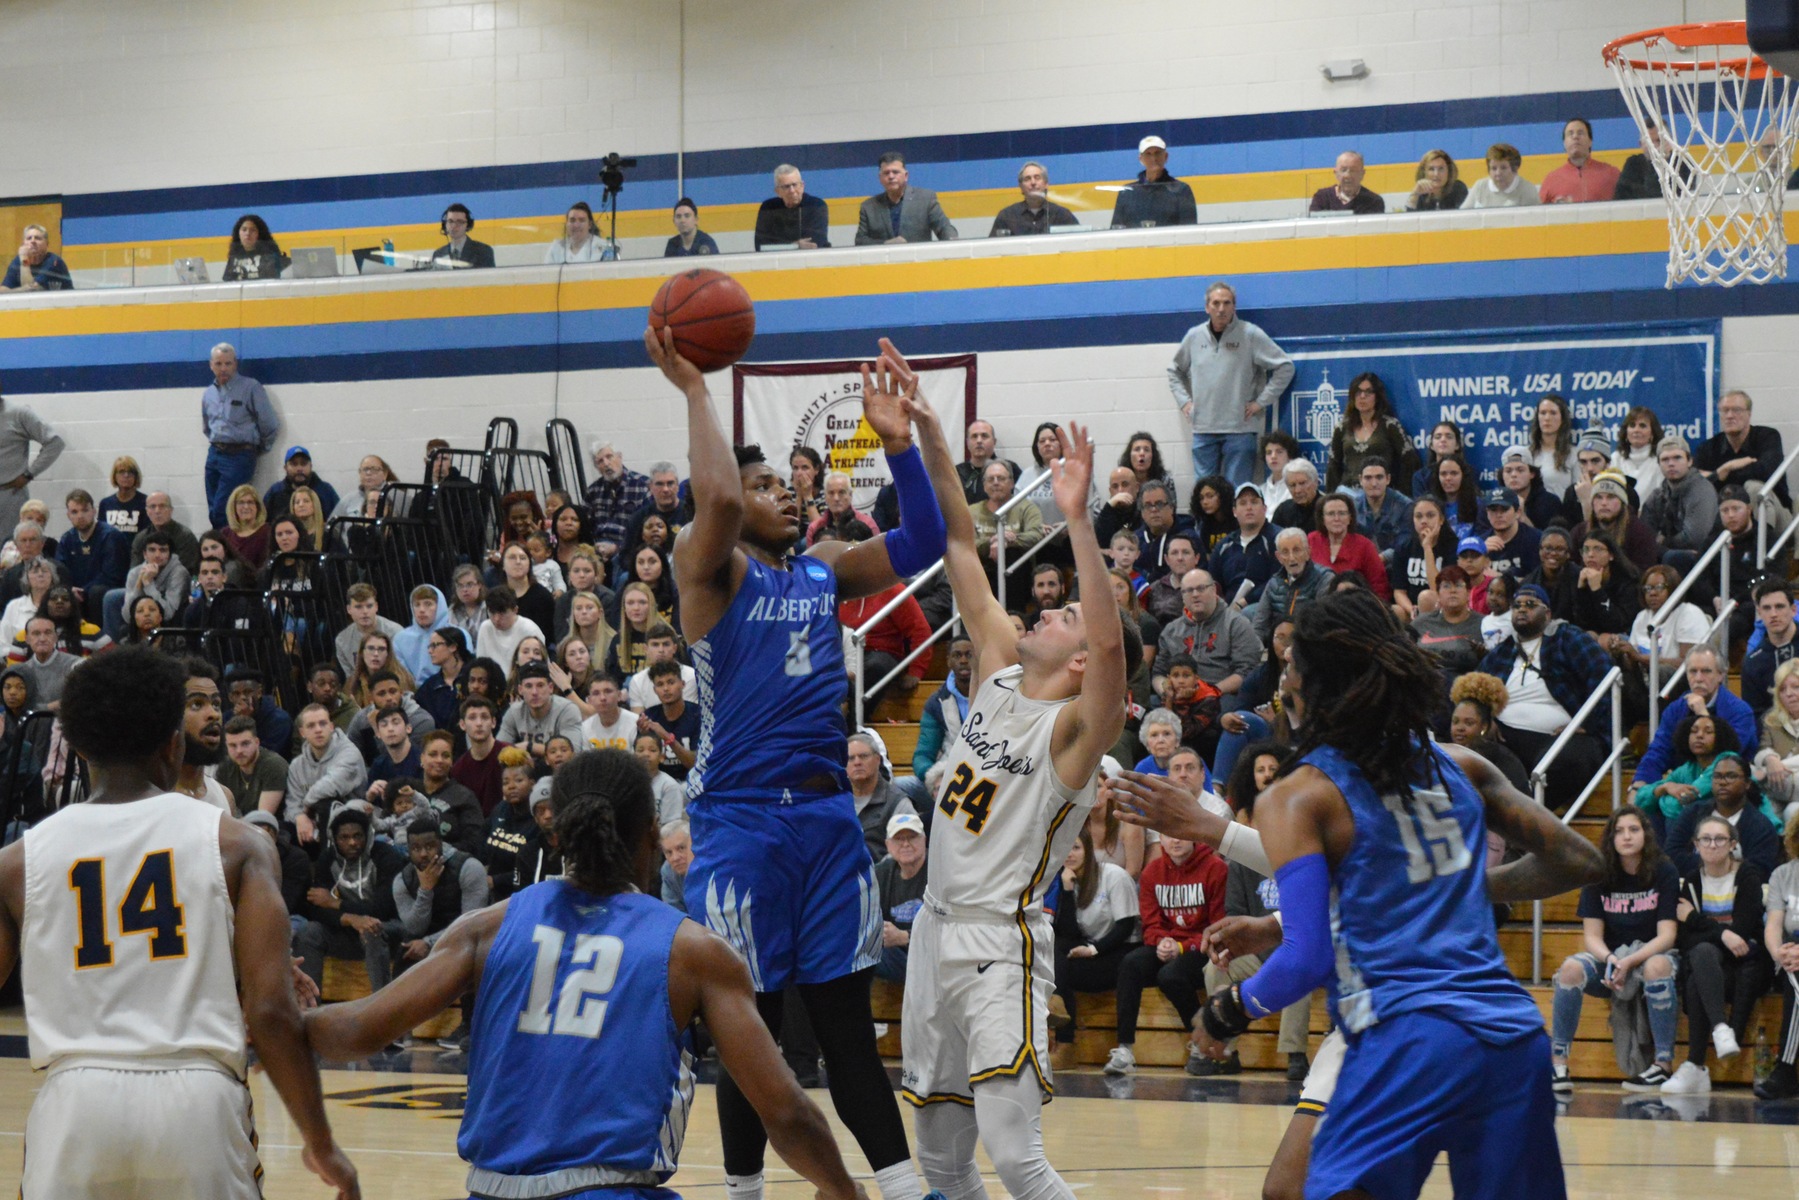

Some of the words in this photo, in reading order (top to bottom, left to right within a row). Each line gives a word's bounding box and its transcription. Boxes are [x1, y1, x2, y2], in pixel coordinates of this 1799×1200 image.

[1418, 375, 1518, 399] WINNER,
[1523, 373, 1562, 393] USA
[1571, 369, 1638, 392] TODAY
[1440, 403, 1502, 424] NCAA
[825, 434, 882, 450] NORTHEAS
[851, 477, 886, 488] ERENCE
[106, 510, 140, 526] USJ
[981, 740, 1035, 776] Joe's
[939, 761, 1000, 837] 24
[1382, 784, 1473, 884] 15
[67, 848, 189, 971] 14
[517, 923, 625, 1040] 12
